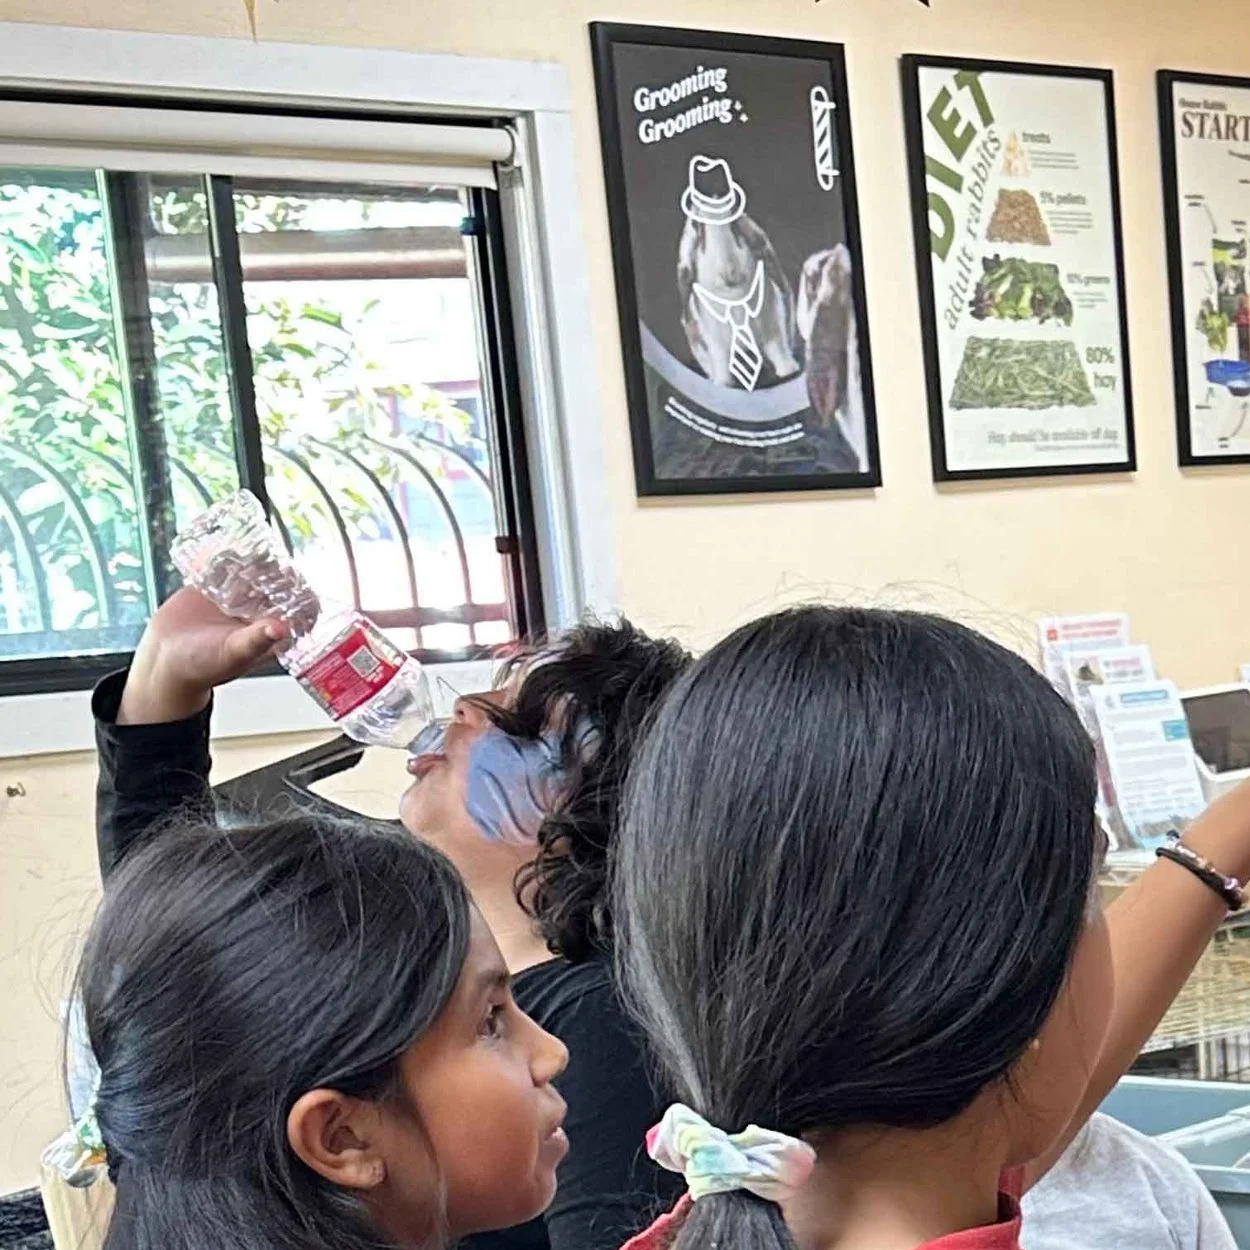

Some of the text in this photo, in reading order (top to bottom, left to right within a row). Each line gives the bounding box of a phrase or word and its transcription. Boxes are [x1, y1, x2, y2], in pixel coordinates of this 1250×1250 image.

[634, 65, 728, 113] Grooming
[638, 97, 733, 144] Grooming
[925, 70, 995, 263] DIET
[944, 130, 1001, 330] adult rabbits
[1085, 346, 1115, 364] 80%
[1093, 371, 1117, 391] hay
